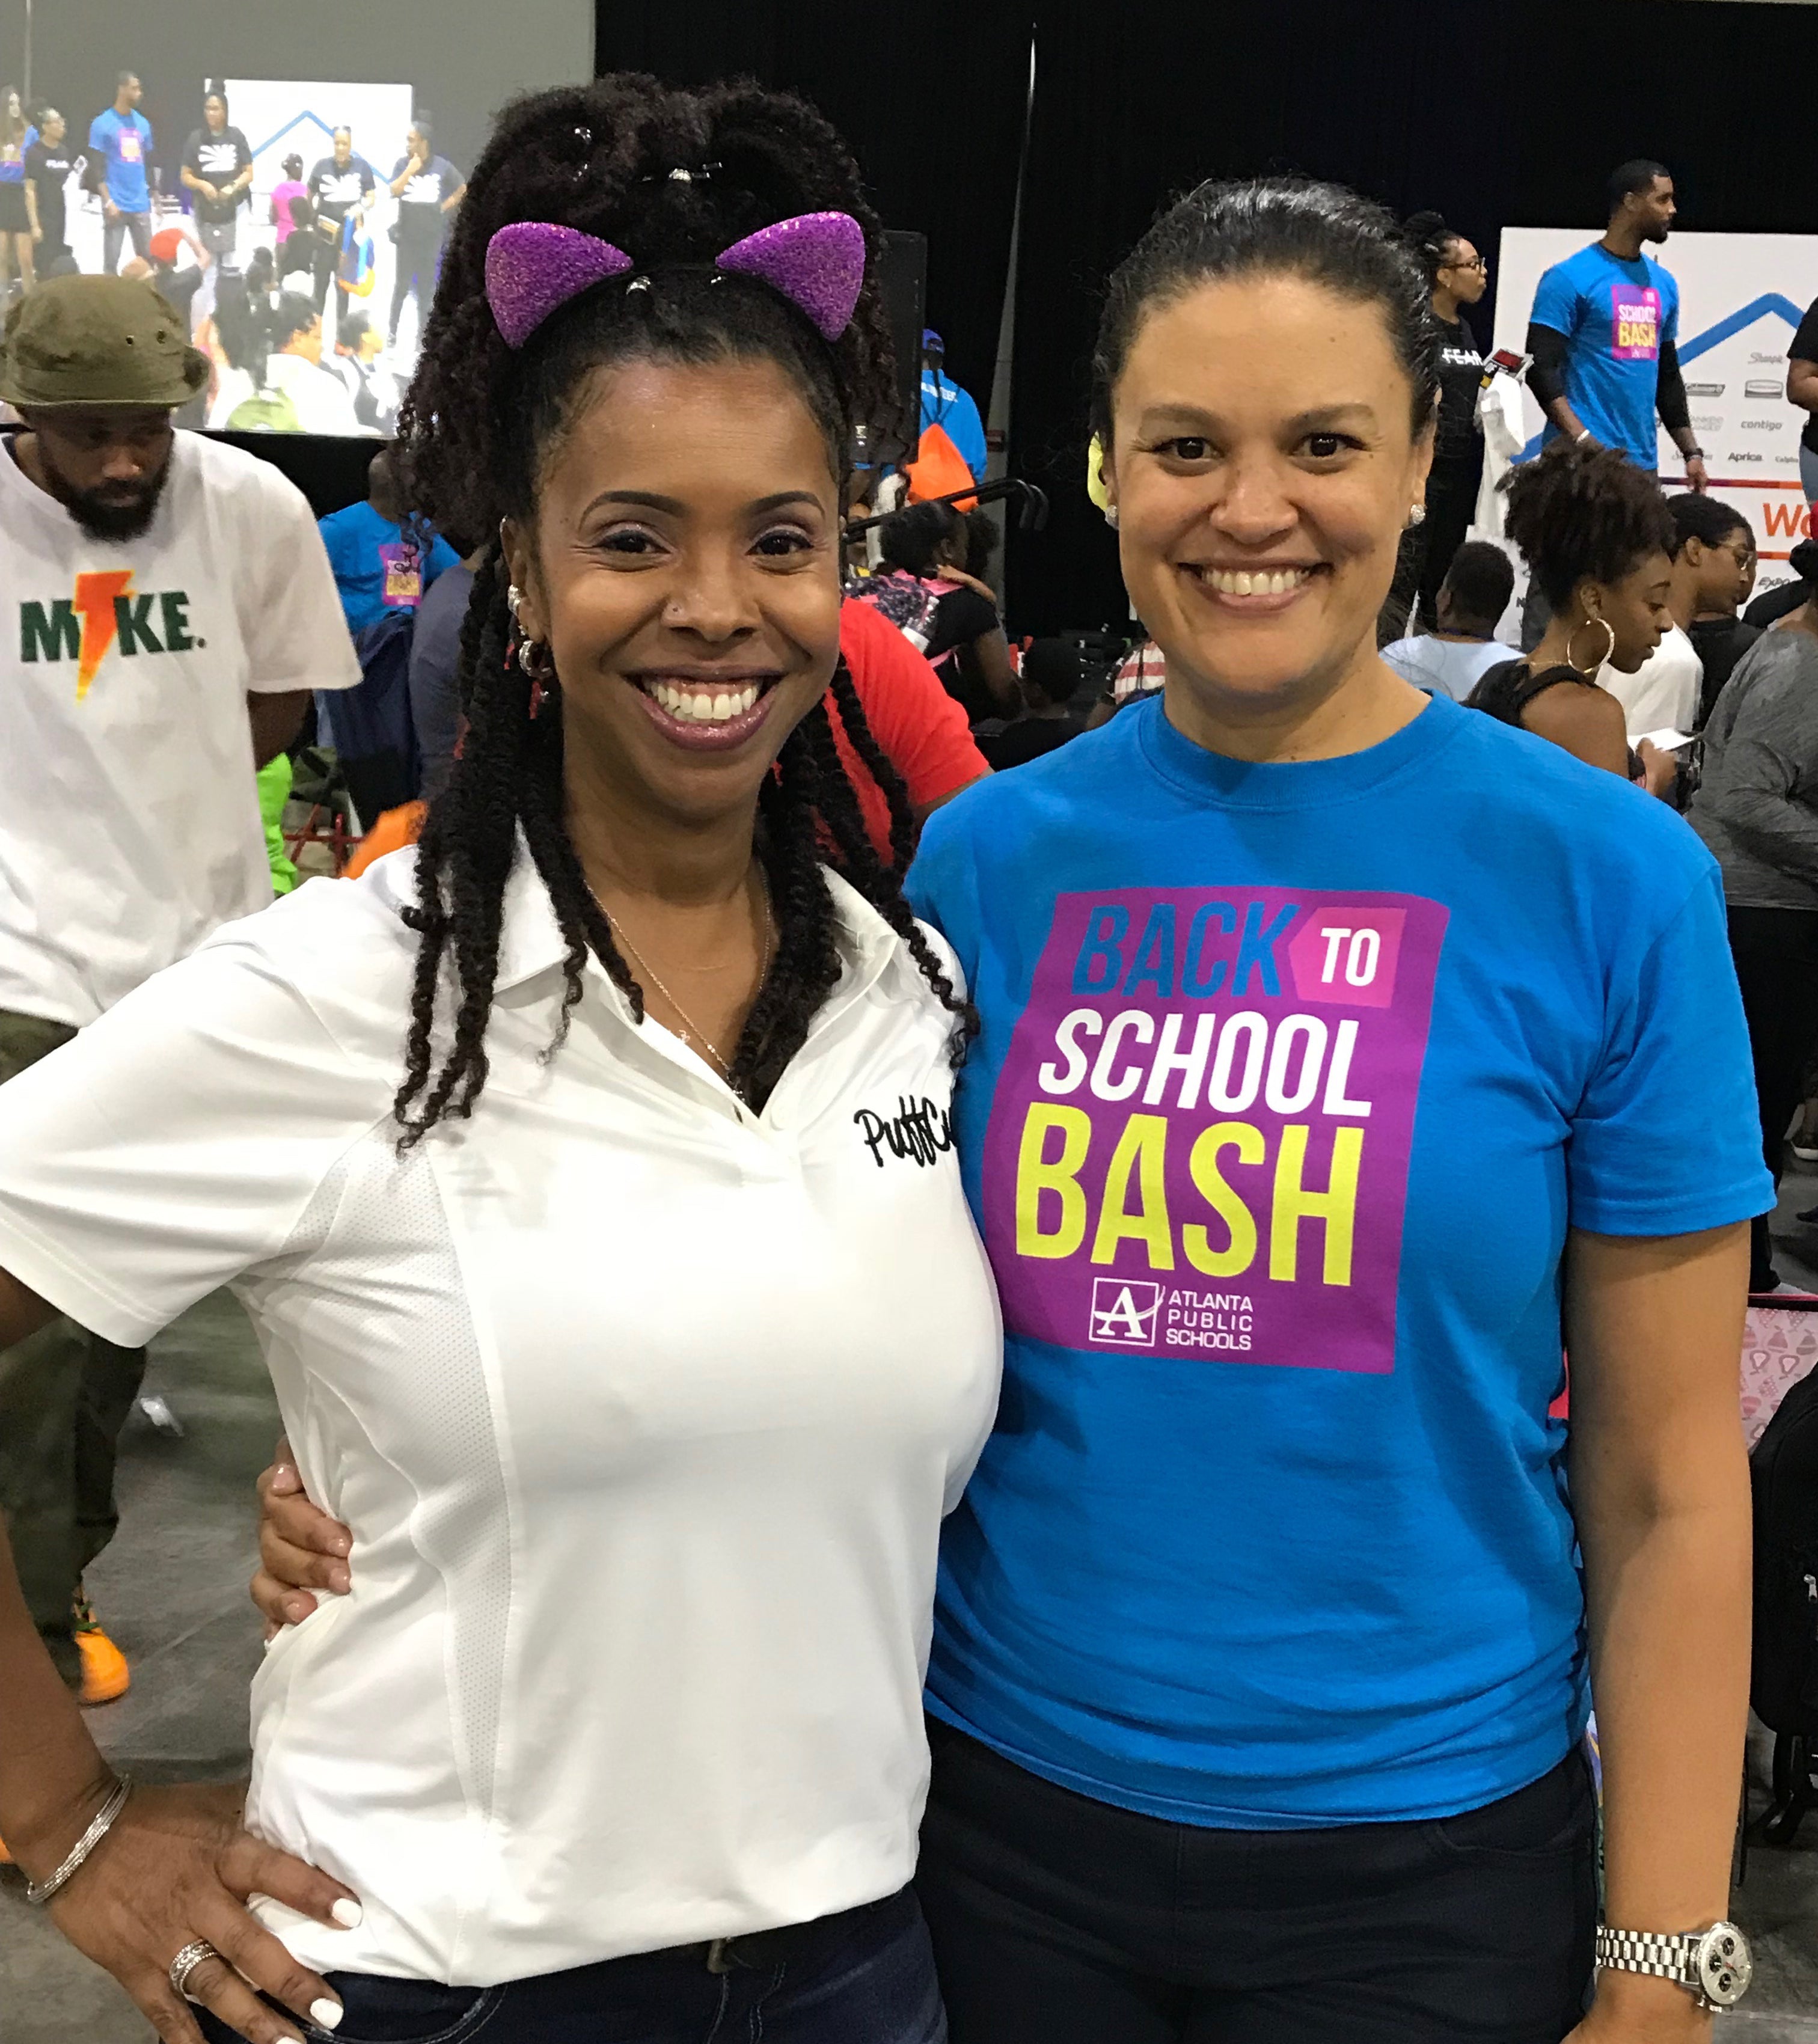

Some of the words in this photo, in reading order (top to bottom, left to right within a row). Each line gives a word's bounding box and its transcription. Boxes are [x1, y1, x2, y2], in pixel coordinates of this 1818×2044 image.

[1618, 322, 1656, 347] BASH
[1740, 420, 1783, 431] contigo
[1071, 902, 1300, 999] BACK
[1320, 928, 1382, 986] TO
[1038, 1008, 1372, 1117] SCHOOL
[1016, 1102, 1364, 1287] BASH
[1169, 1290, 1253, 1312] ATLANTA
[1168, 1309, 1252, 1332] PUBLIC
[1166, 1328, 1252, 1350] SCHOOLS
